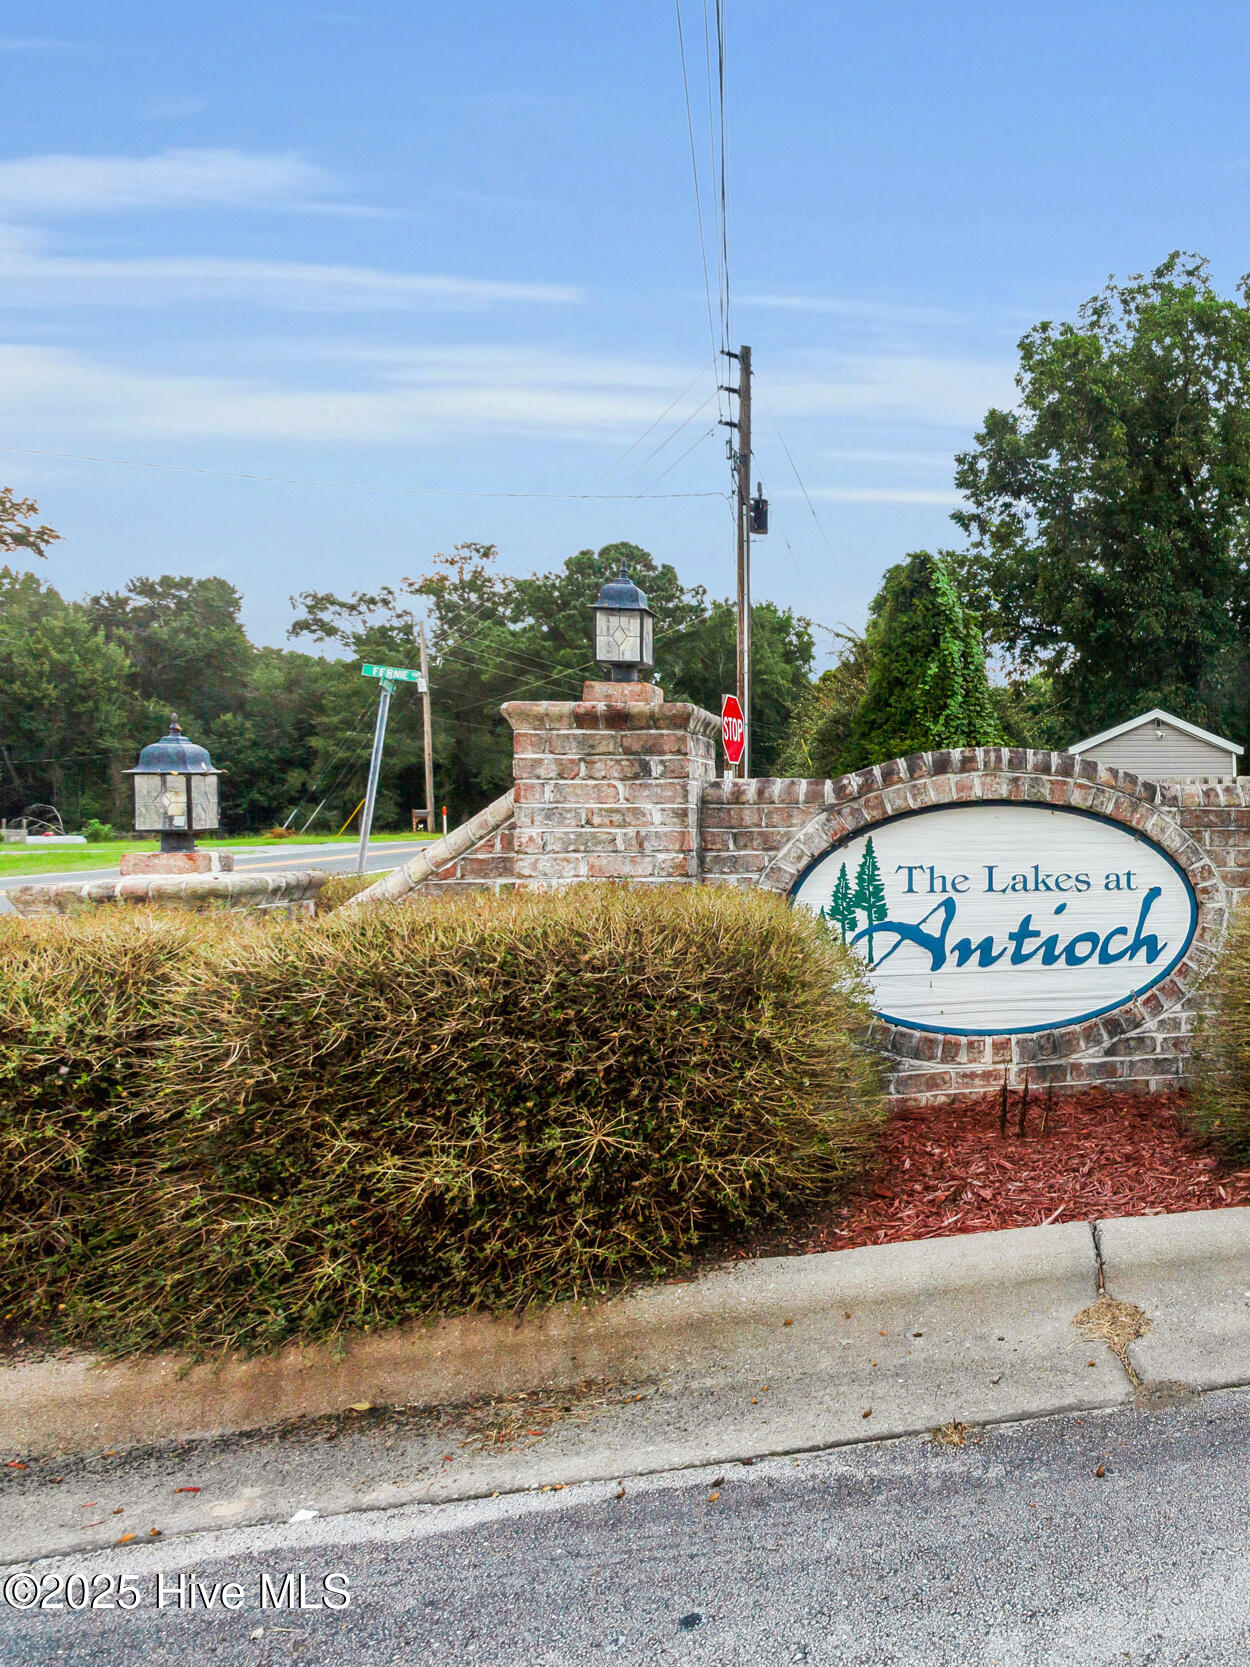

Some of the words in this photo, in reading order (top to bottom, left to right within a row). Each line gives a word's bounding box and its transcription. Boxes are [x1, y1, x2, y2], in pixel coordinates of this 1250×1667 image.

[372, 666, 409, 680] FERNIE
[723, 716, 743, 742] STOP
[895, 864, 971, 894] The
[982, 864, 1091, 894] Lakes
[1104, 869, 1138, 891] at
[851, 886, 1168, 972] Antioch
